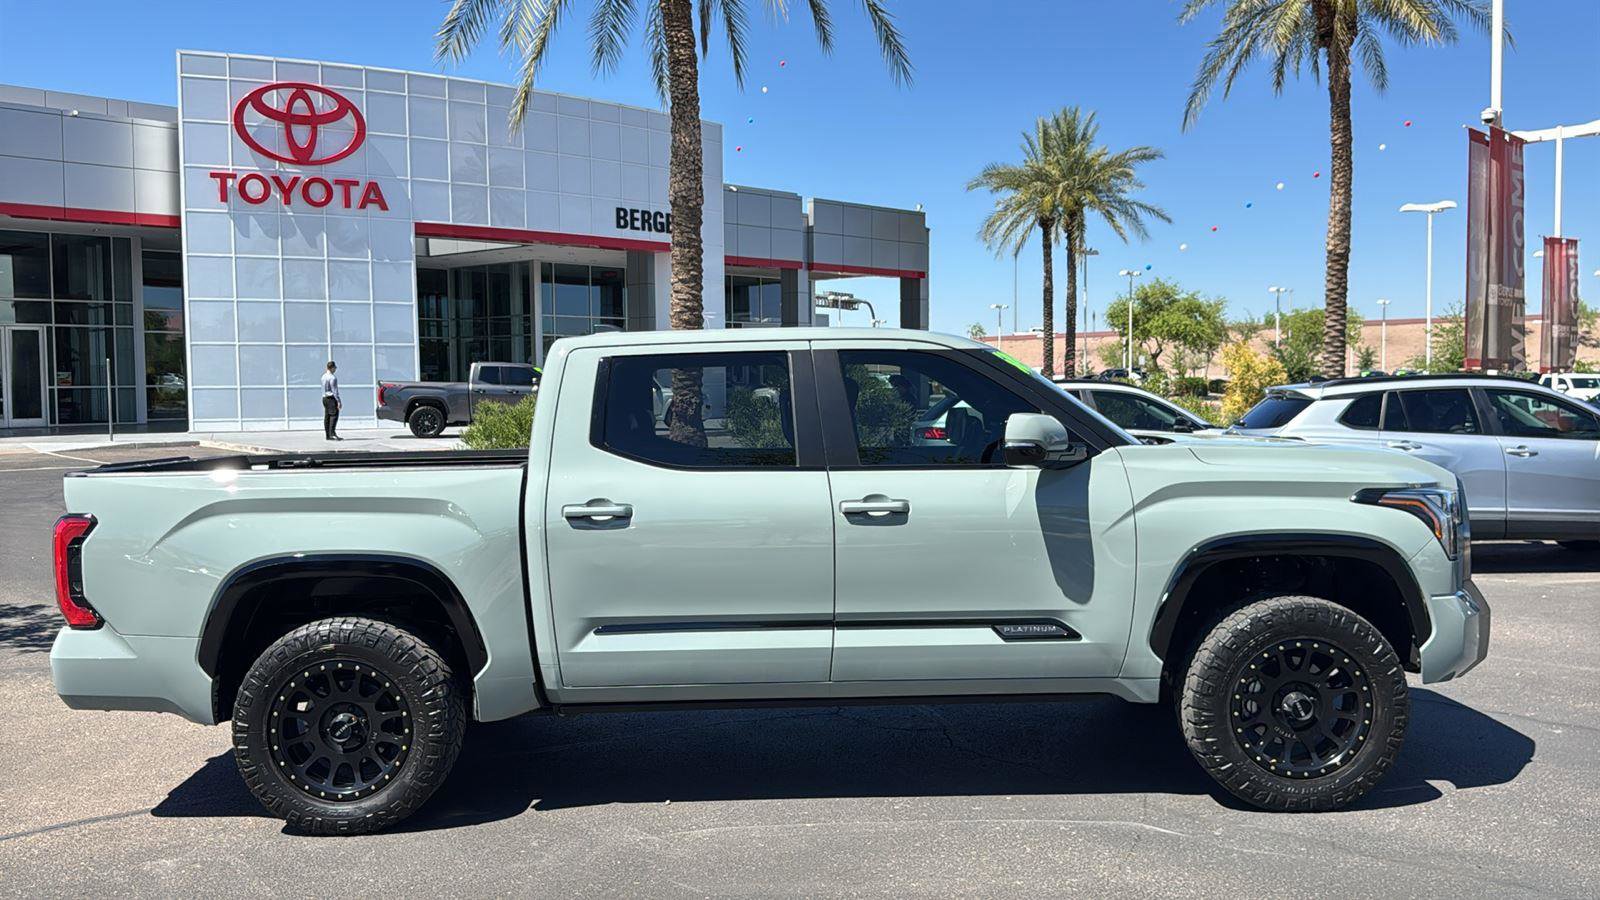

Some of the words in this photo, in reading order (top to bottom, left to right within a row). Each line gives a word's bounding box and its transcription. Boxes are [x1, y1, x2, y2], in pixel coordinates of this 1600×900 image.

[210, 172, 389, 211] TOYOTA
[1511, 140, 1525, 371] WELCOME
[1003, 625, 1057, 633] PLATINUM
